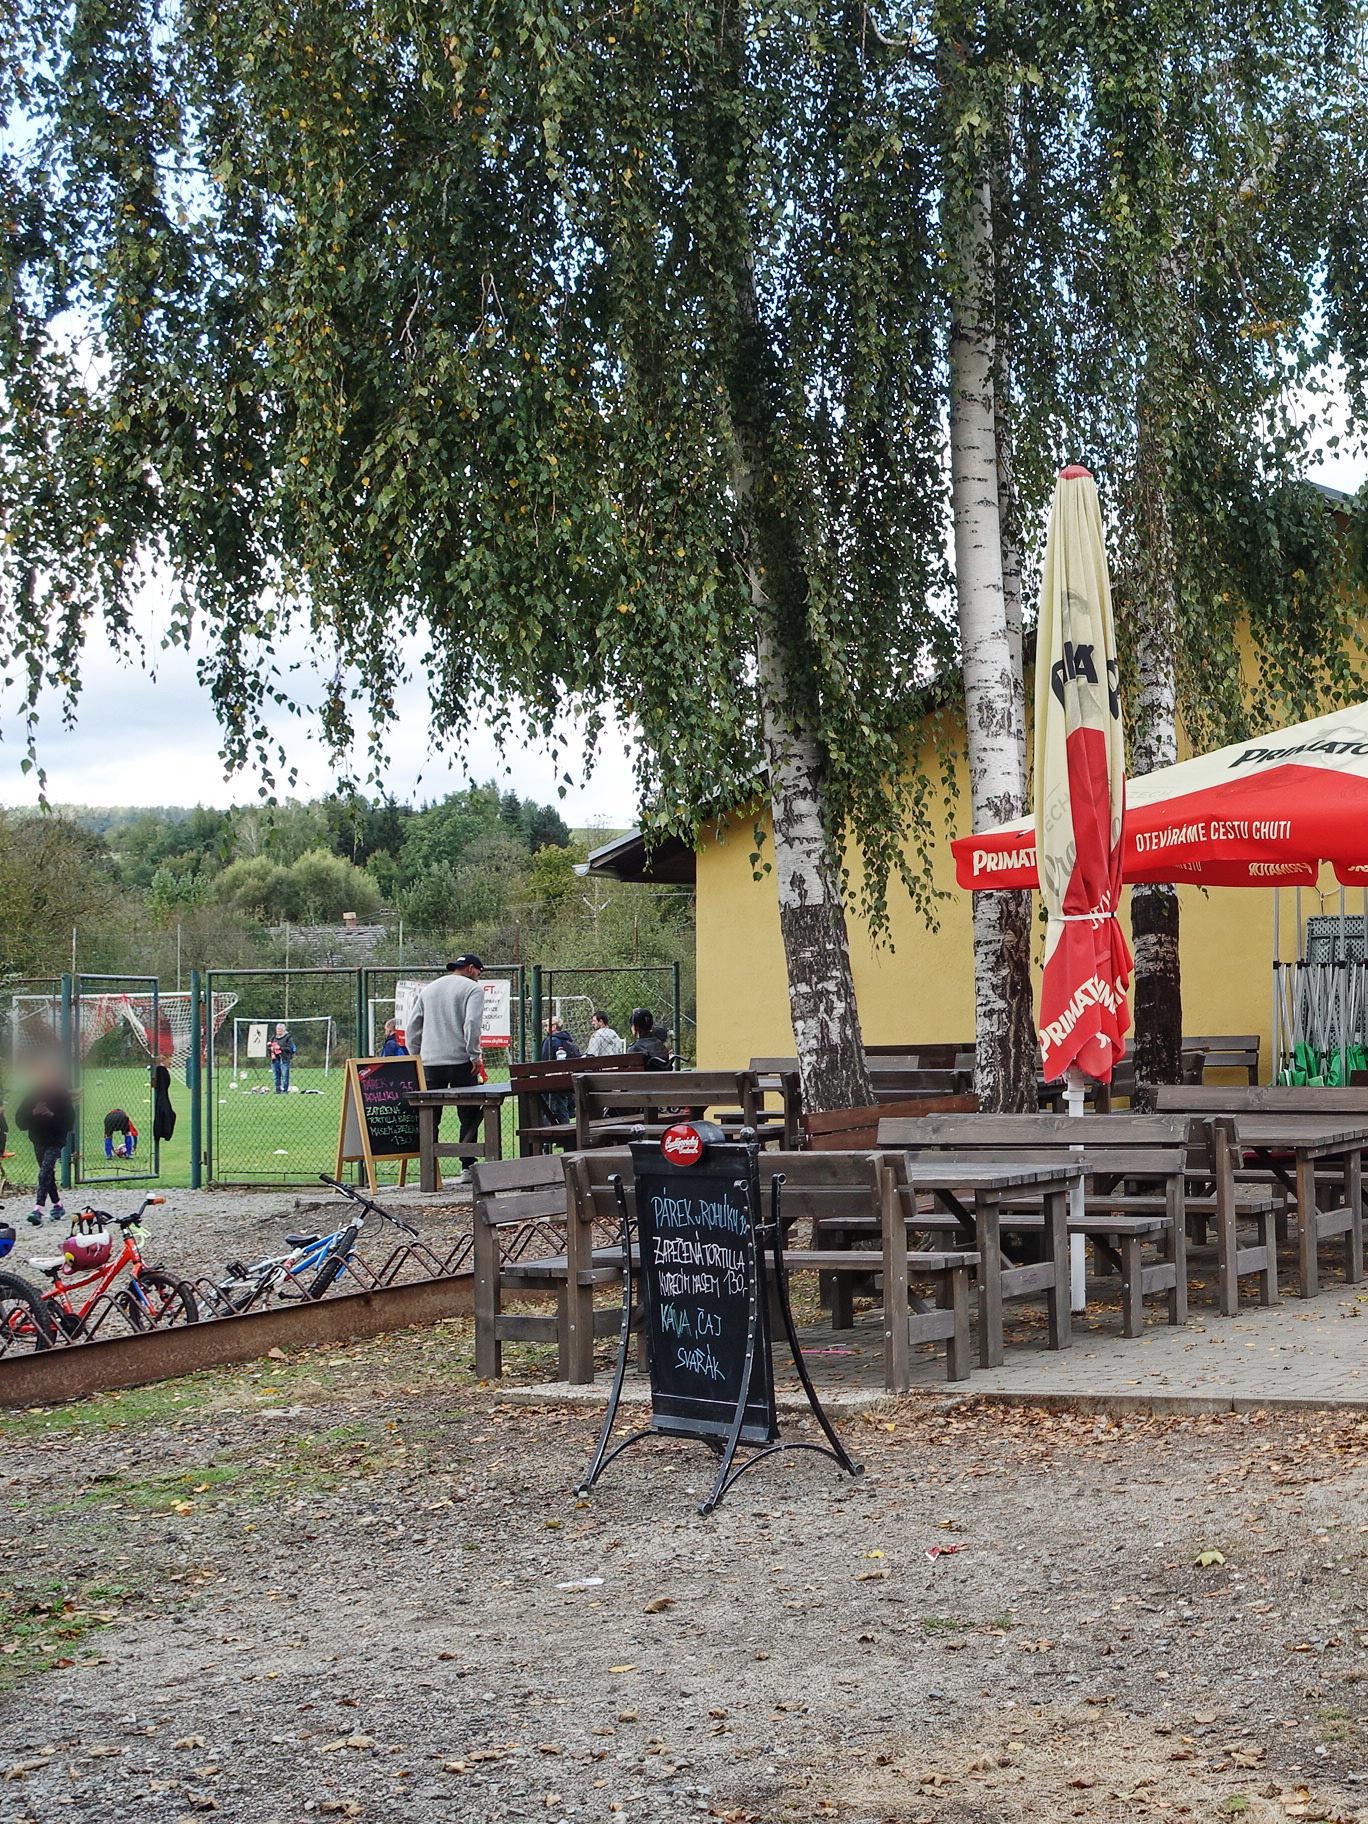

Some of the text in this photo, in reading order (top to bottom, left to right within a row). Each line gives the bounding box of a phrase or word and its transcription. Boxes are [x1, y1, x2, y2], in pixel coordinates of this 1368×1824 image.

[1136, 821, 1291, 852] OTEVÍRÁME CESTU CHUTI
[972, 848, 1036, 876] PRIMAT
[1038, 976, 1100, 1063] PRIMAT
[651, 1187, 695, 1229] PÁREK
[698, 1193, 739, 1234] ROHLÍKU
[652, 1230, 745, 1273] ZAPEČENÁ TORTILLA
[691, 1273, 721, 1298] MASEM
[675, 1344, 726, 1381] SVAŘÁK
